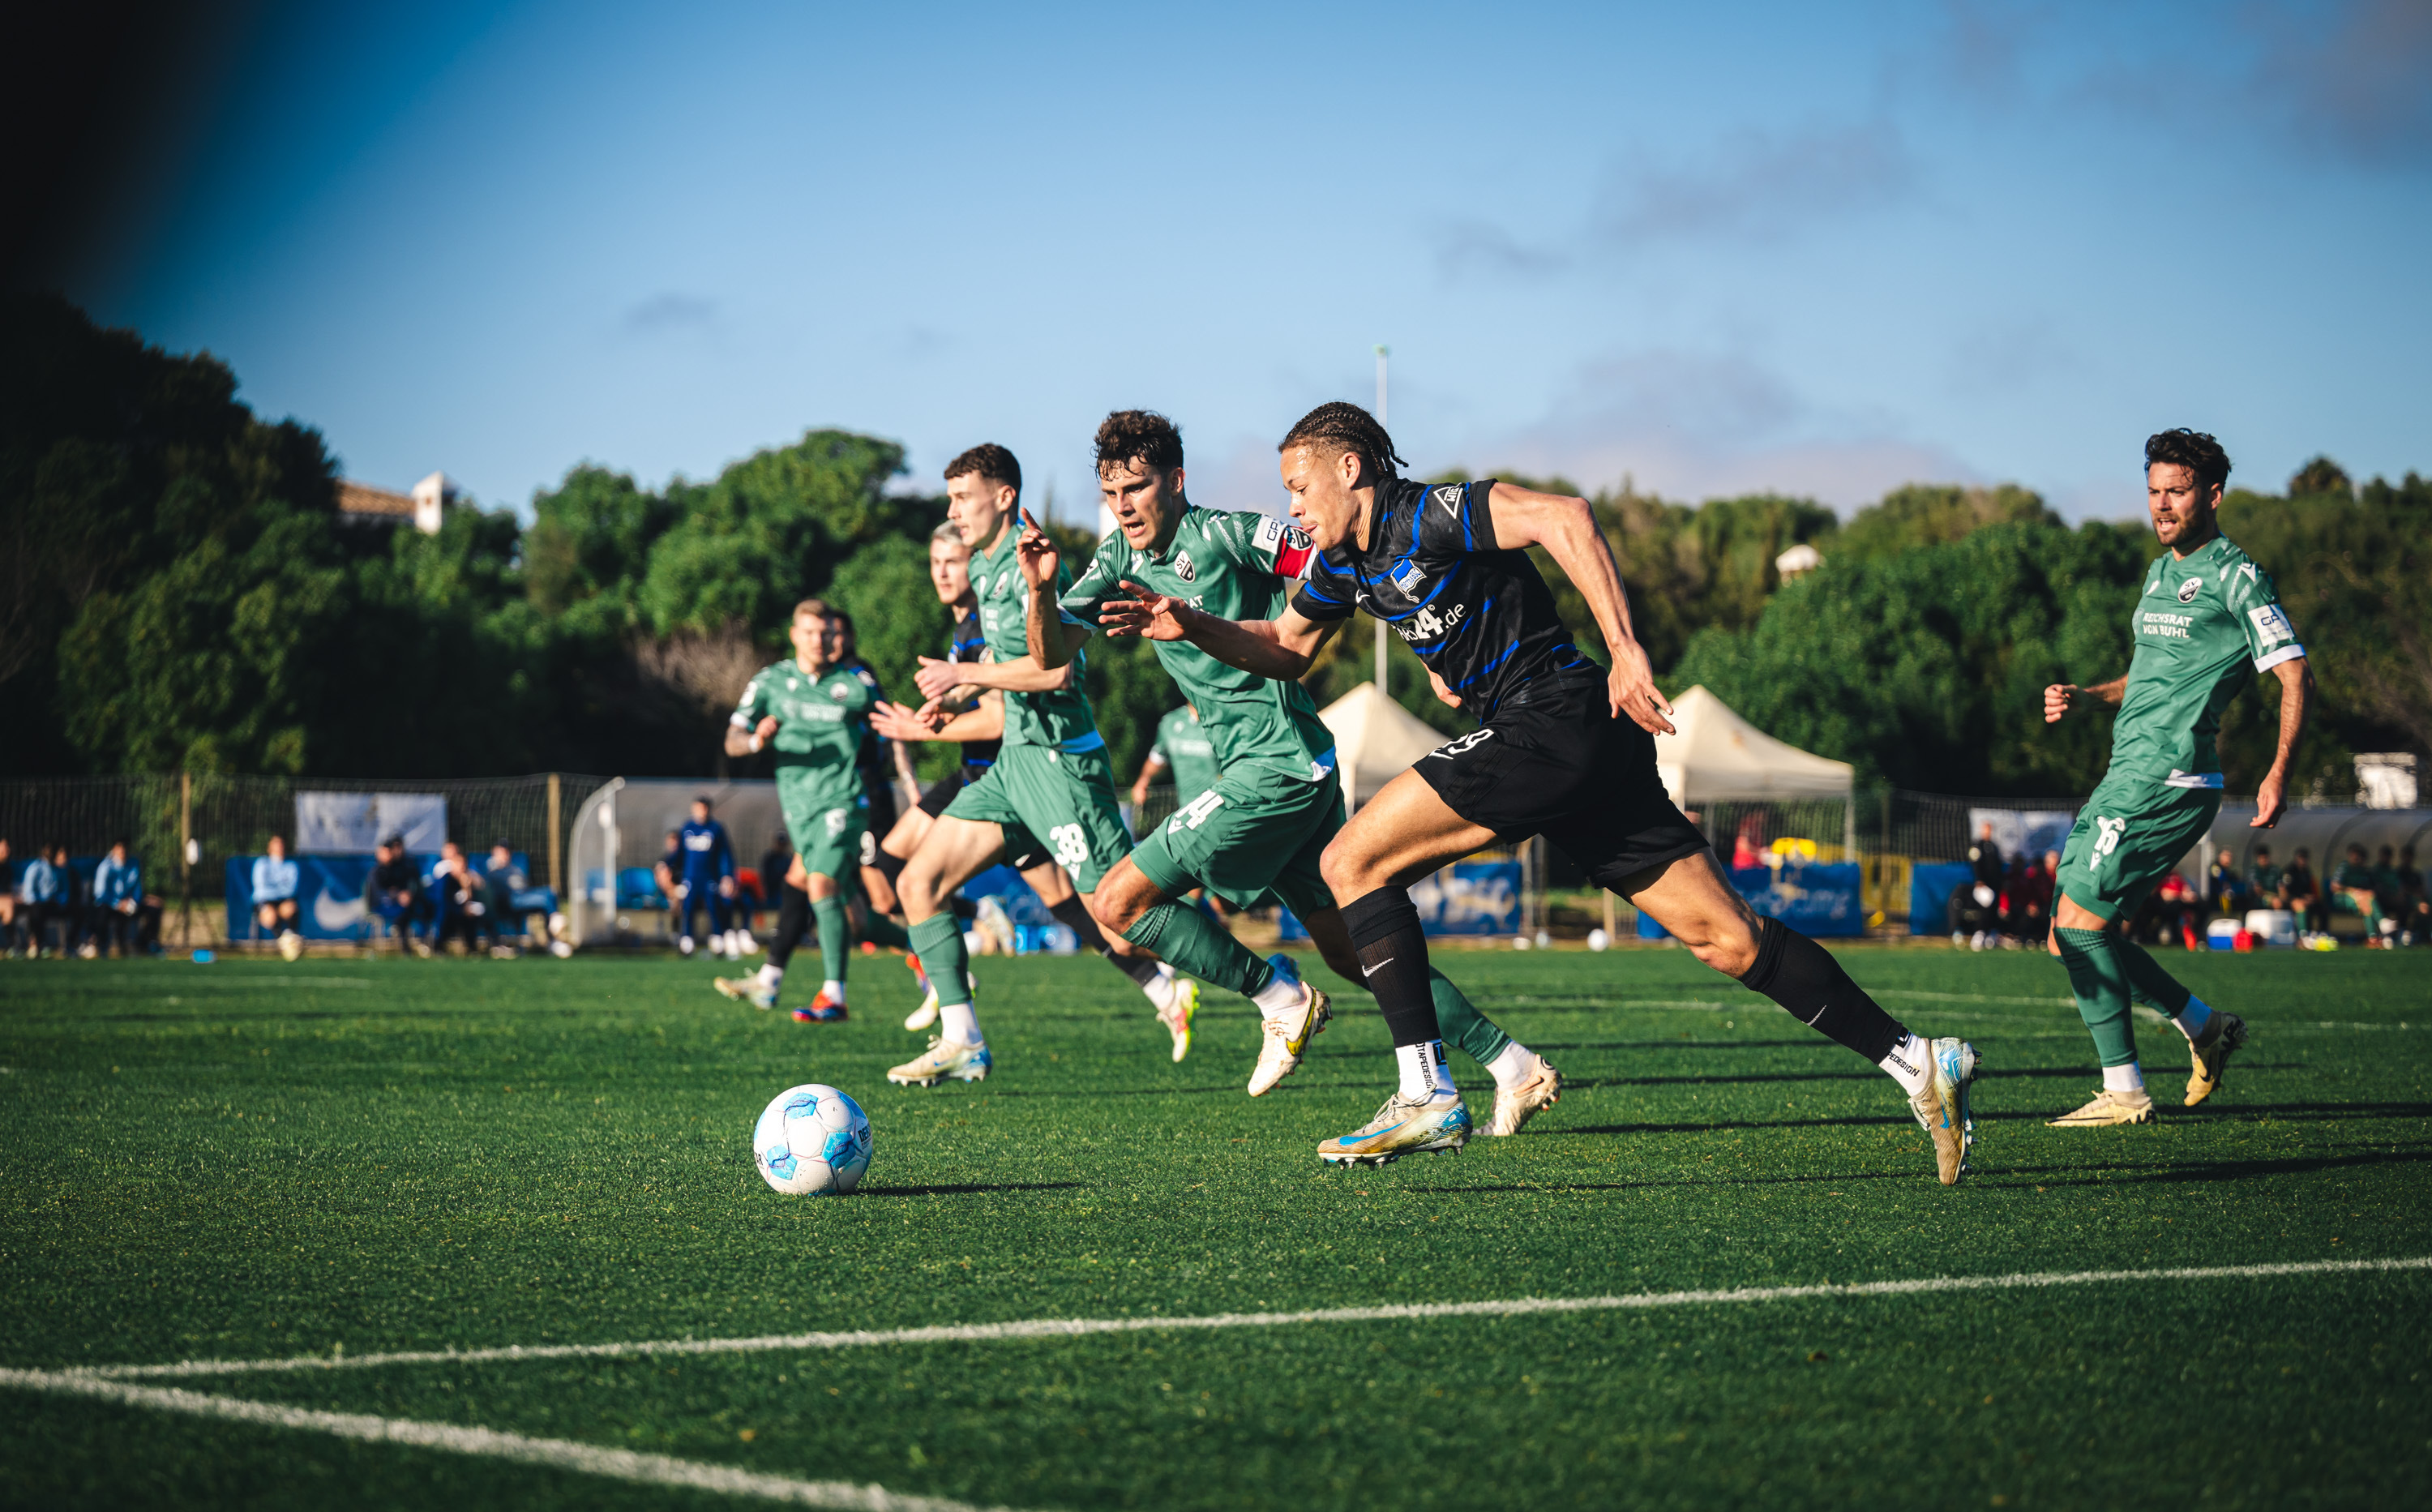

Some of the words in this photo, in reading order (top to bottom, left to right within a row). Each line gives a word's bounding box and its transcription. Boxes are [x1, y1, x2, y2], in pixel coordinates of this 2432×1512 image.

[1175, 554, 1186, 570] SV
[2142, 612, 2194, 628] REICHSRAT
[2142, 623, 2159, 635] VON
[1174, 789, 1225, 831] 14
[1049, 822, 1089, 867] 38
[2094, 816, 2126, 855] 16
